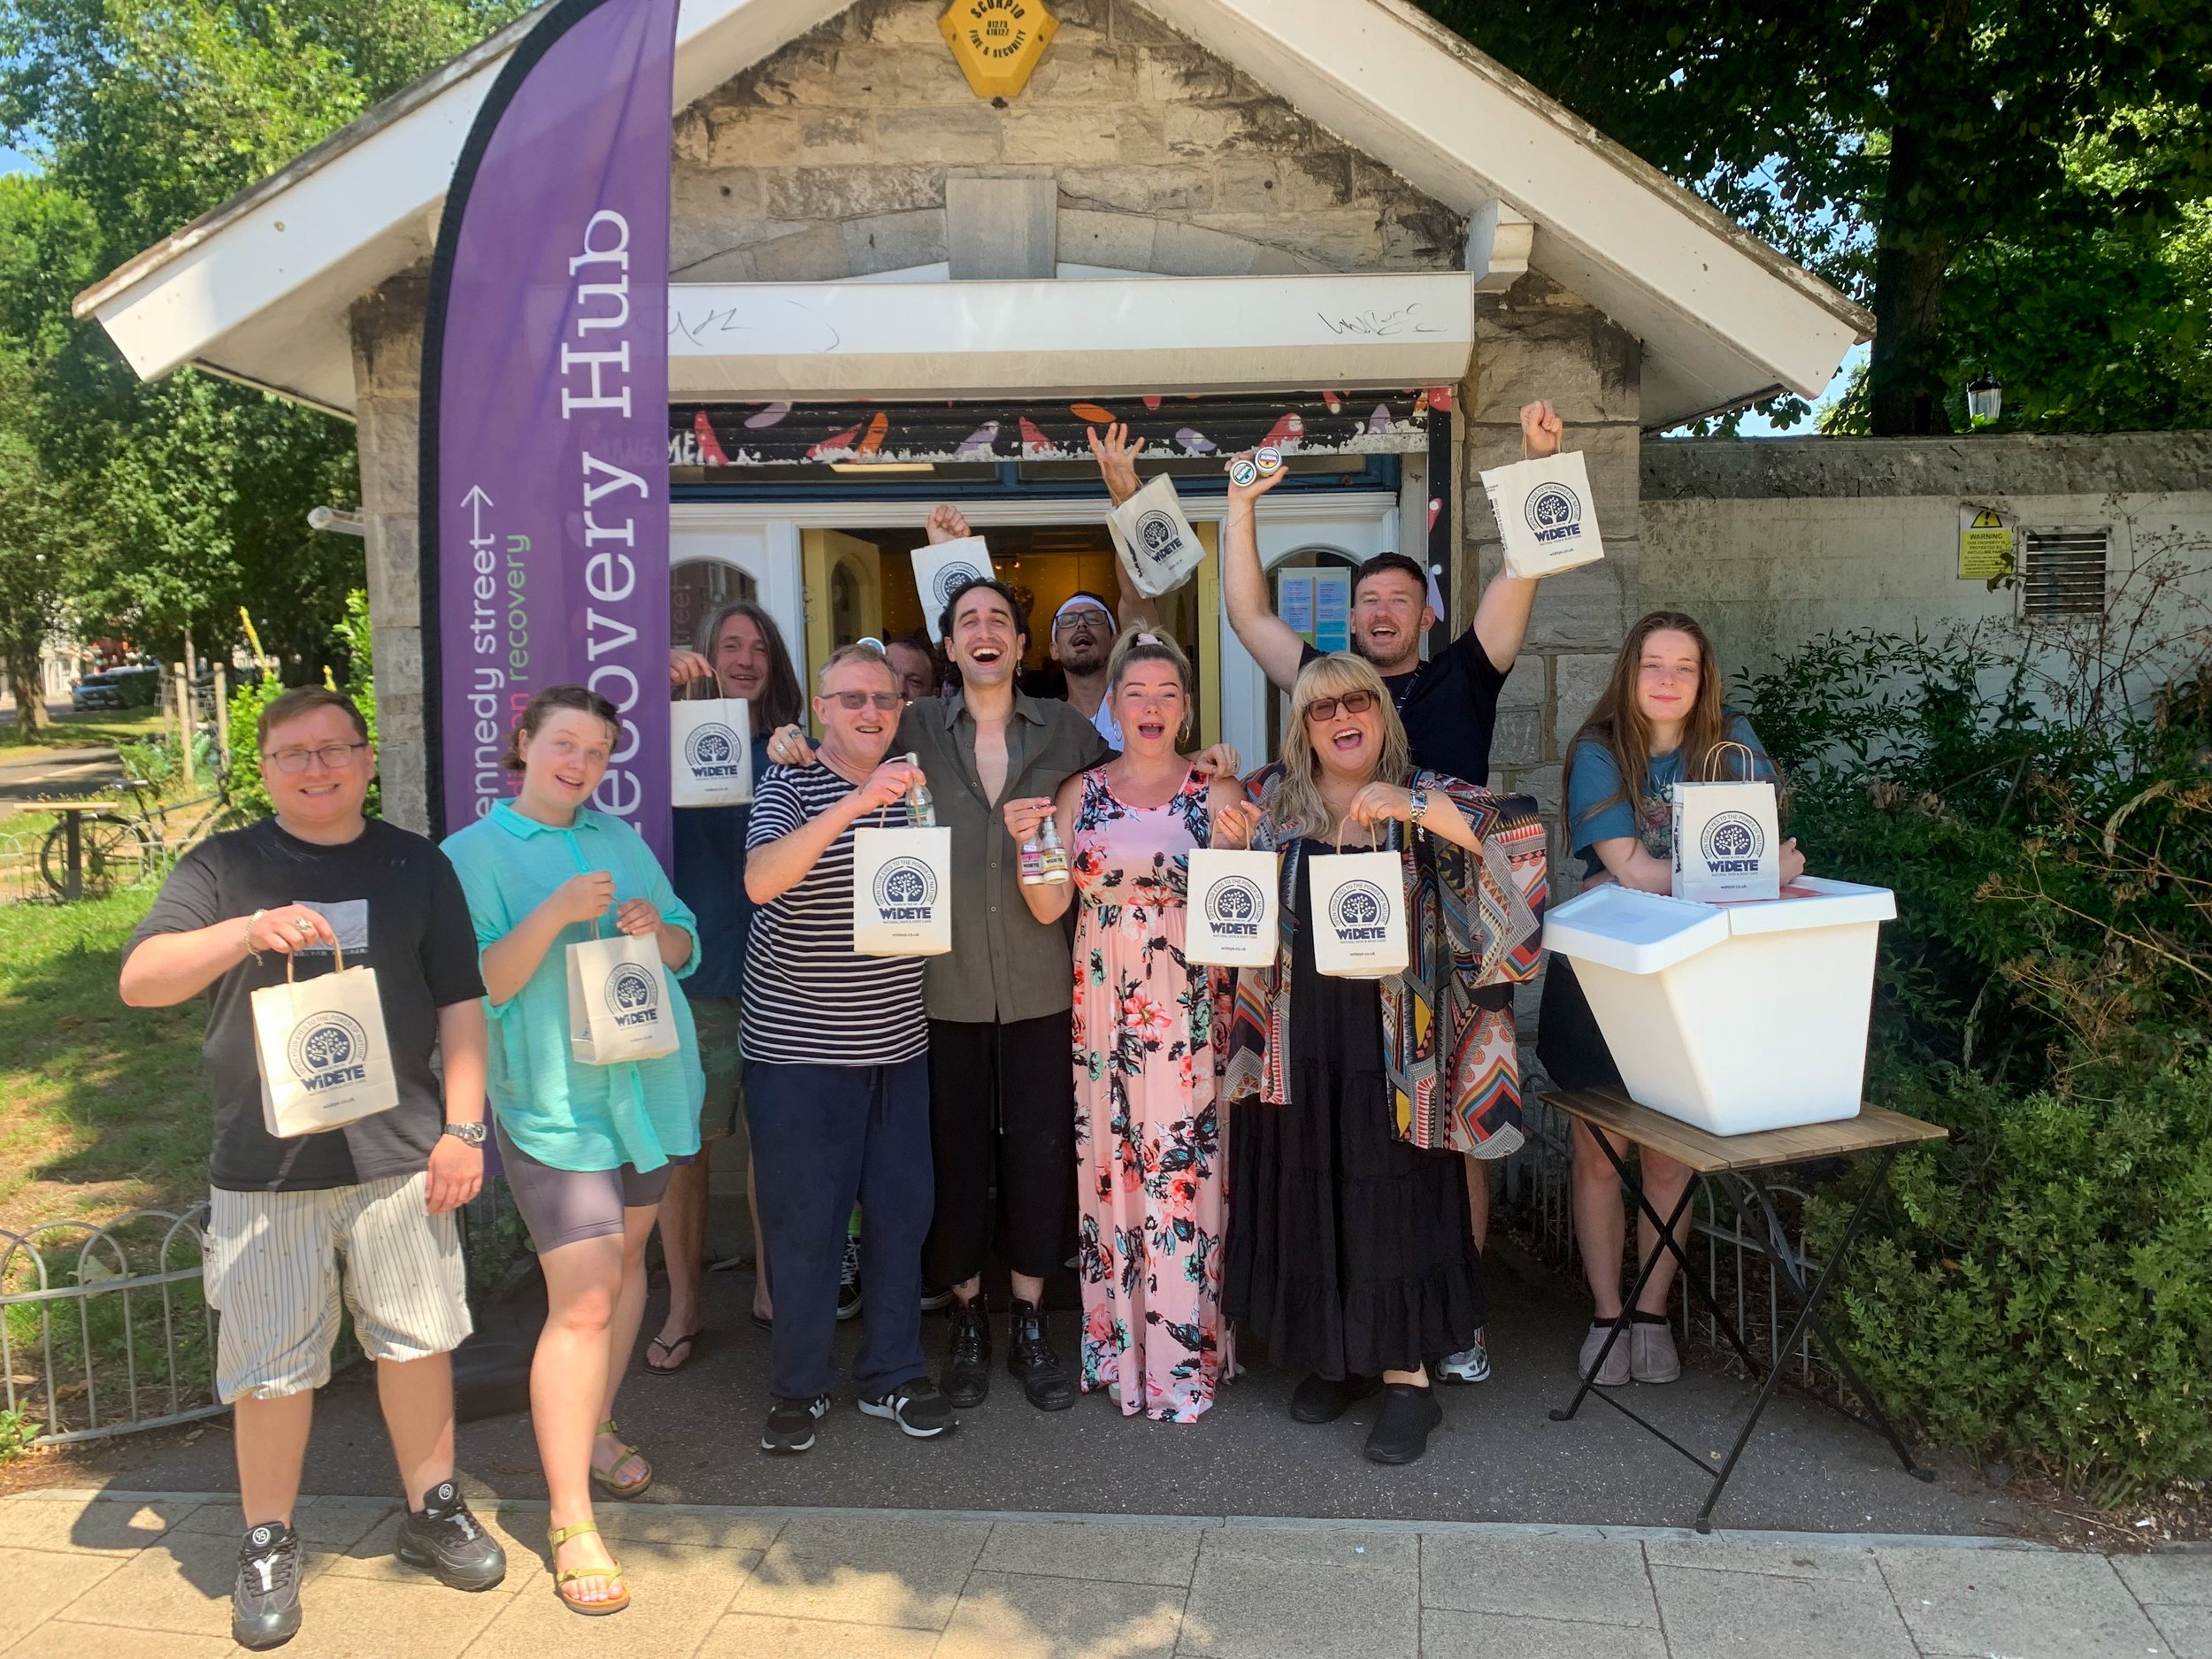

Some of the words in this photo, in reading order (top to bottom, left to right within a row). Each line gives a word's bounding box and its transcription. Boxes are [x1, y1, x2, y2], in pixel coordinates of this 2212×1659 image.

[970, 0, 1025, 19] SCORPIO
[968, 29, 983, 49] FIRE
[993, 29, 1026, 58] SECURITY
[561, 209, 631, 420] Hub
[1534, 524, 1580, 542] WiDEYE
[469, 533, 497, 655] street
[506, 533, 531, 681] recovery
[581, 451, 649, 836] ecovery
[467, 667, 505, 819] ennedy
[1707, 860, 1758, 872] WiDEYE
[879, 907, 931, 920] WiDEYE
[1210, 922, 1258, 935] WiDEYE
[1335, 927, 1385, 940] WiDEYE
[301, 1064, 366, 1091] WiDEYE
[256, 1531, 266, 1541] 95
